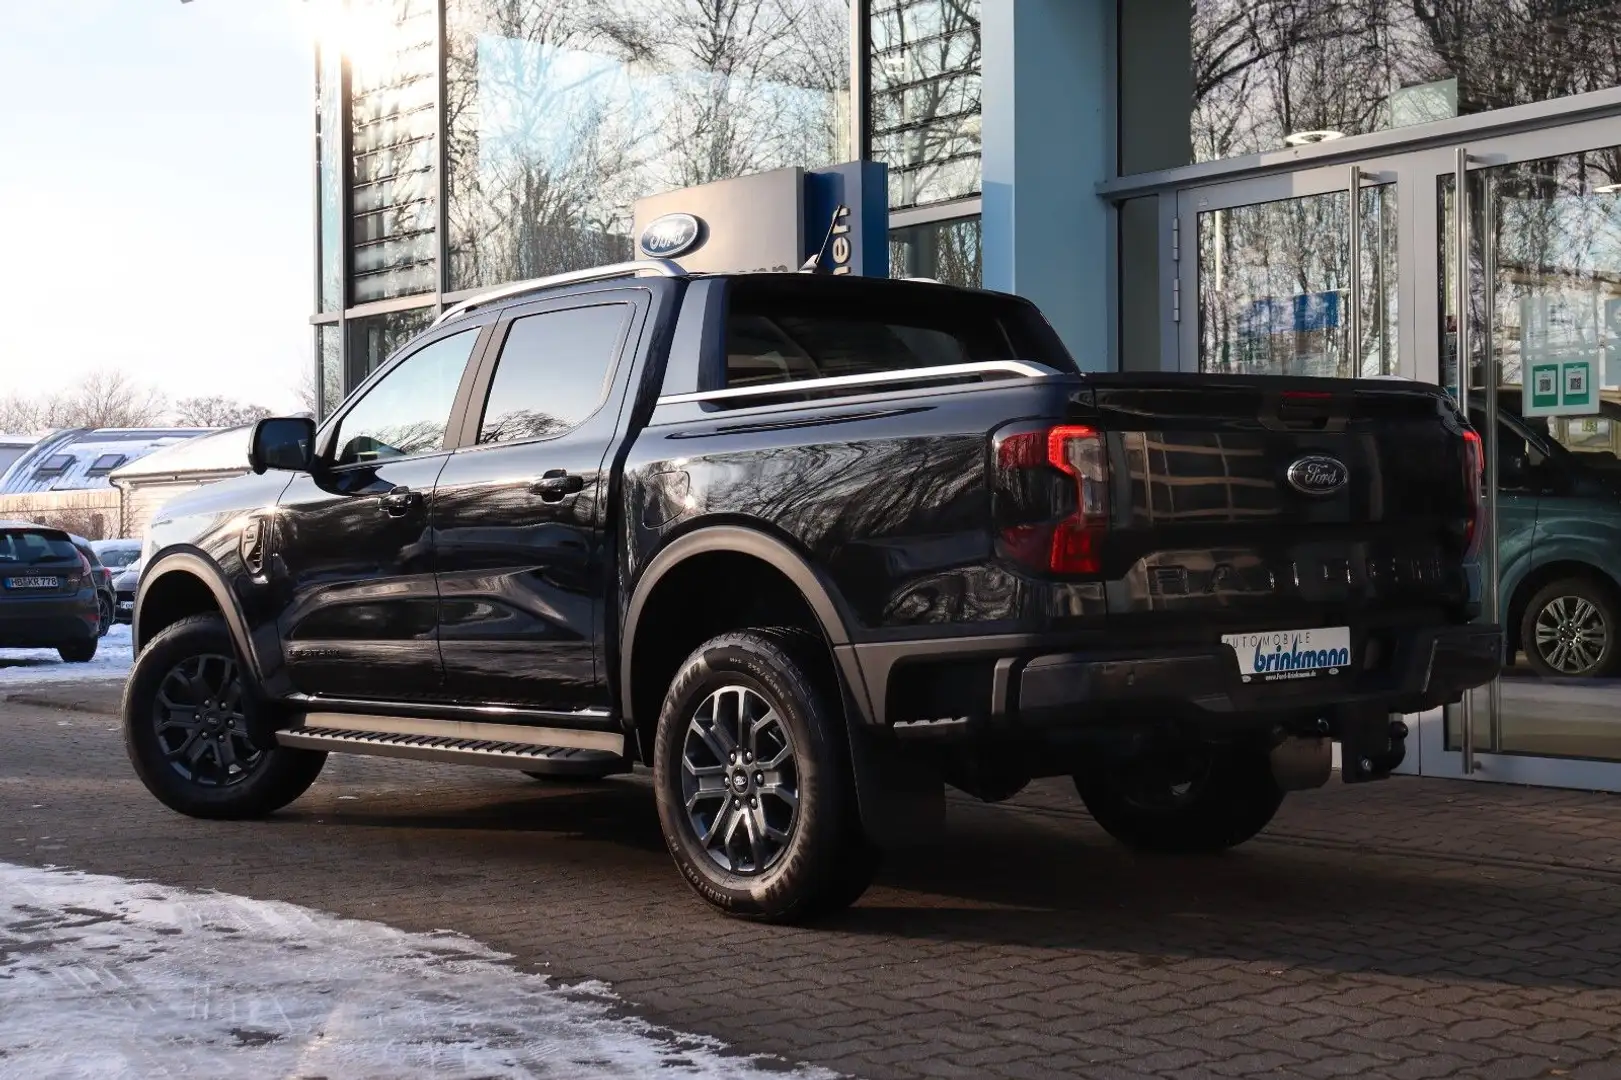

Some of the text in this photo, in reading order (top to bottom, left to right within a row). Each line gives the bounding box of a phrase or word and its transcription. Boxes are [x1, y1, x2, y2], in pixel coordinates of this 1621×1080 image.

[1303, 462, 1339, 486] Ford
[1226, 632, 1311, 648] AUTOMOBILE
[1254, 635, 1349, 672] brinkmann
